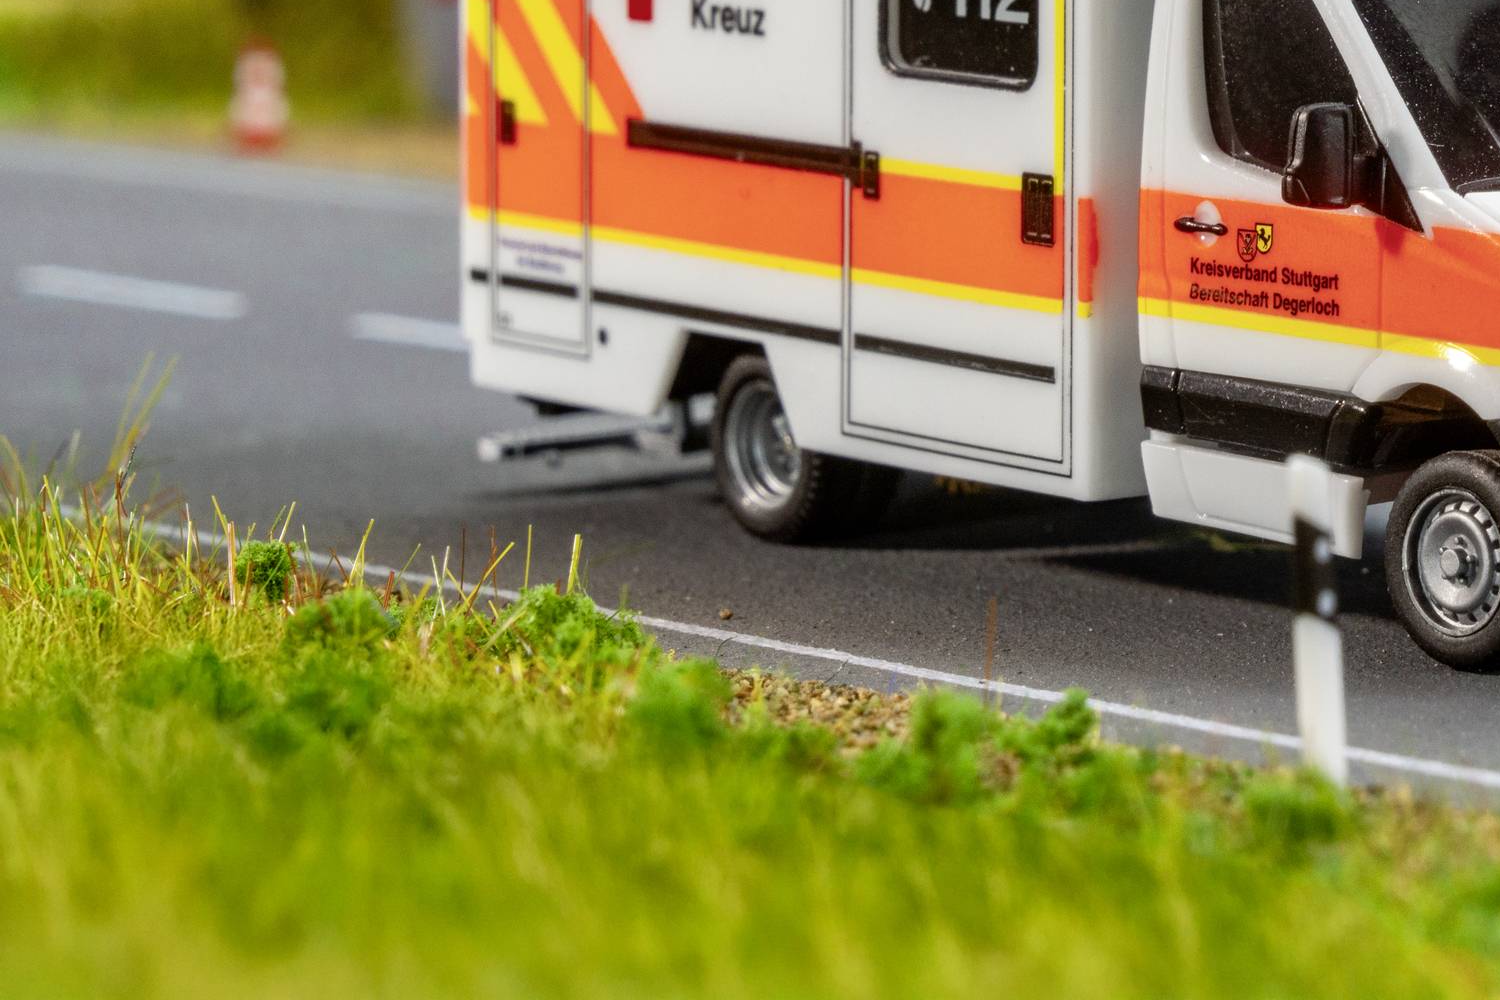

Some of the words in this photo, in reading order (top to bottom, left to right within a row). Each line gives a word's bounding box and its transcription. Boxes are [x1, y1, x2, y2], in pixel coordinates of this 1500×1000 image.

[1190, 257, 1277, 283] Kreisverband
[1281, 267, 1339, 292] Stuttgart
[1189, 283, 1269, 308] Bereitschaft
[1273, 292, 1340, 317] Degerloch
